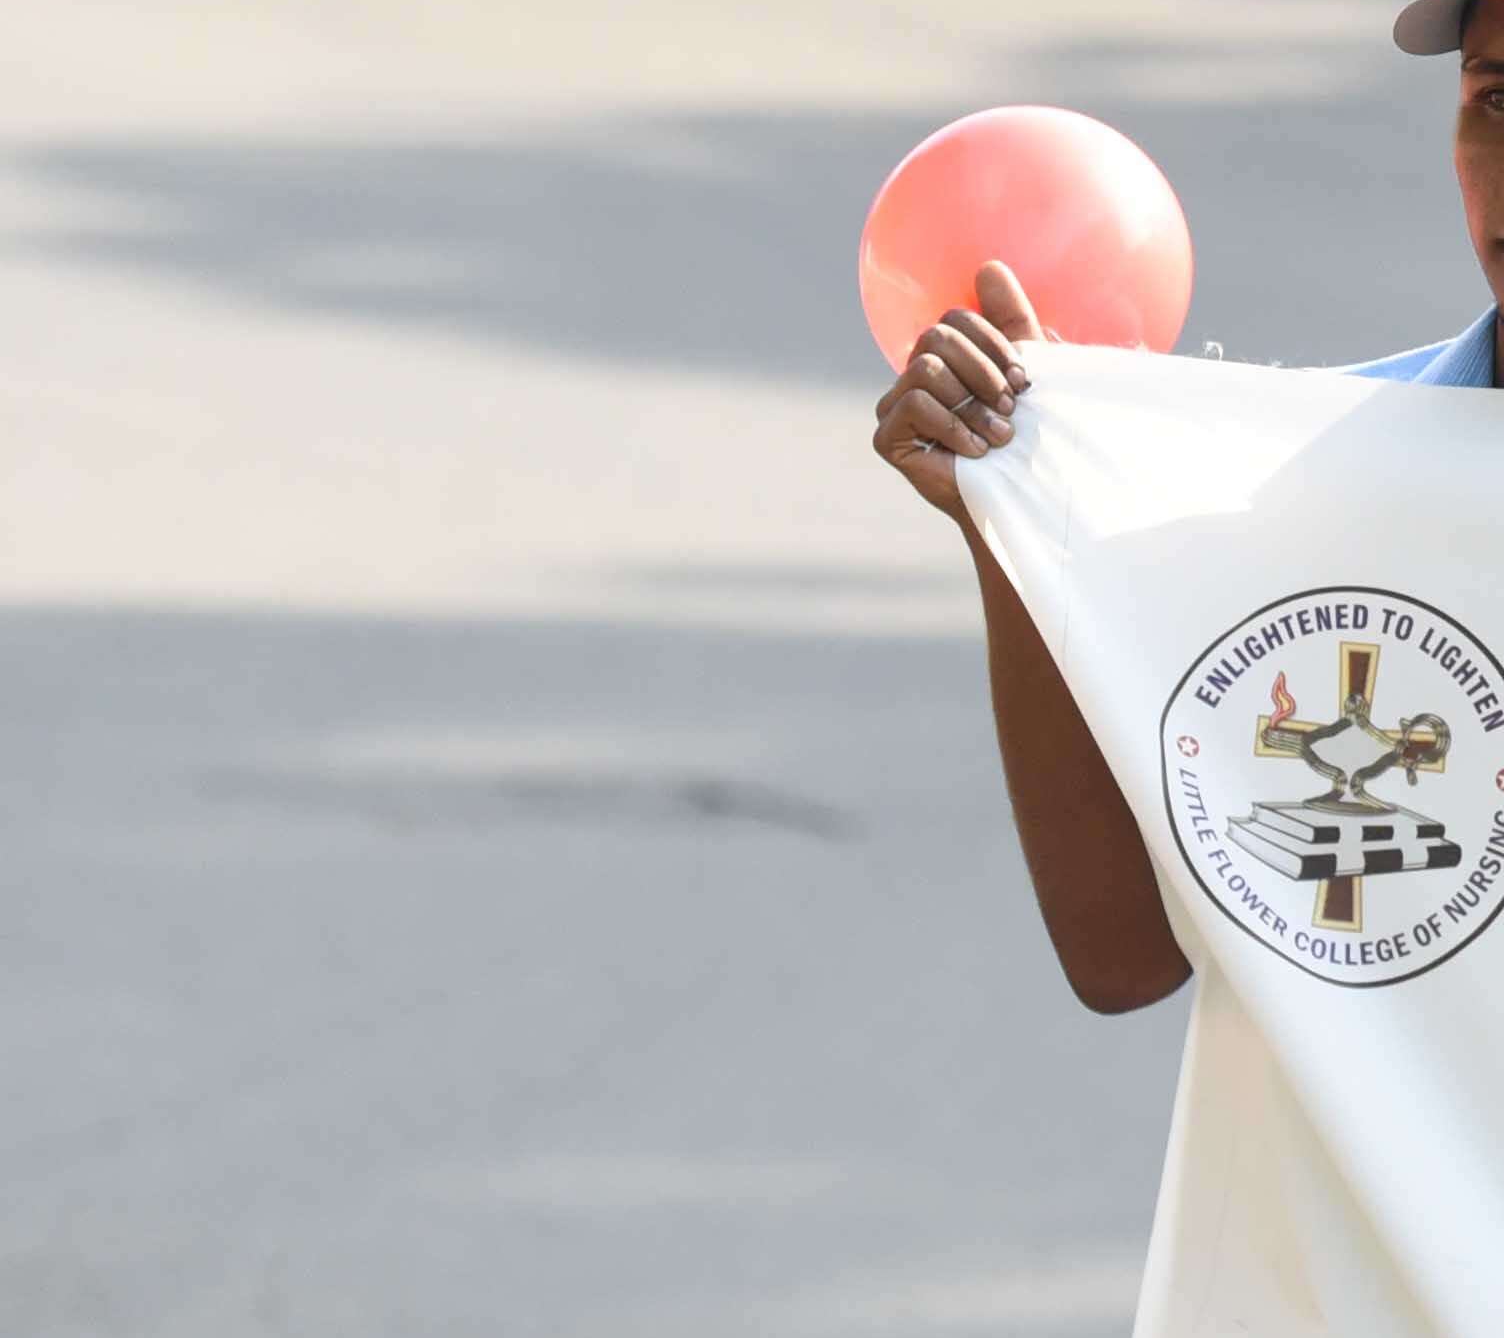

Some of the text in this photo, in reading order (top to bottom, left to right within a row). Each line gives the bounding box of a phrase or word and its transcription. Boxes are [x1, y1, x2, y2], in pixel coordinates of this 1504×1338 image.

[1194, 603, 1370, 709] ENLIGHTENED
[1380, 607, 1414, 641] TO
[1179, 767, 1217, 845] LITTLE
[1208, 848, 1288, 938] FLOWER
[1293, 929, 1411, 966] COLLEGE
[1412, 913, 1444, 949] OF
